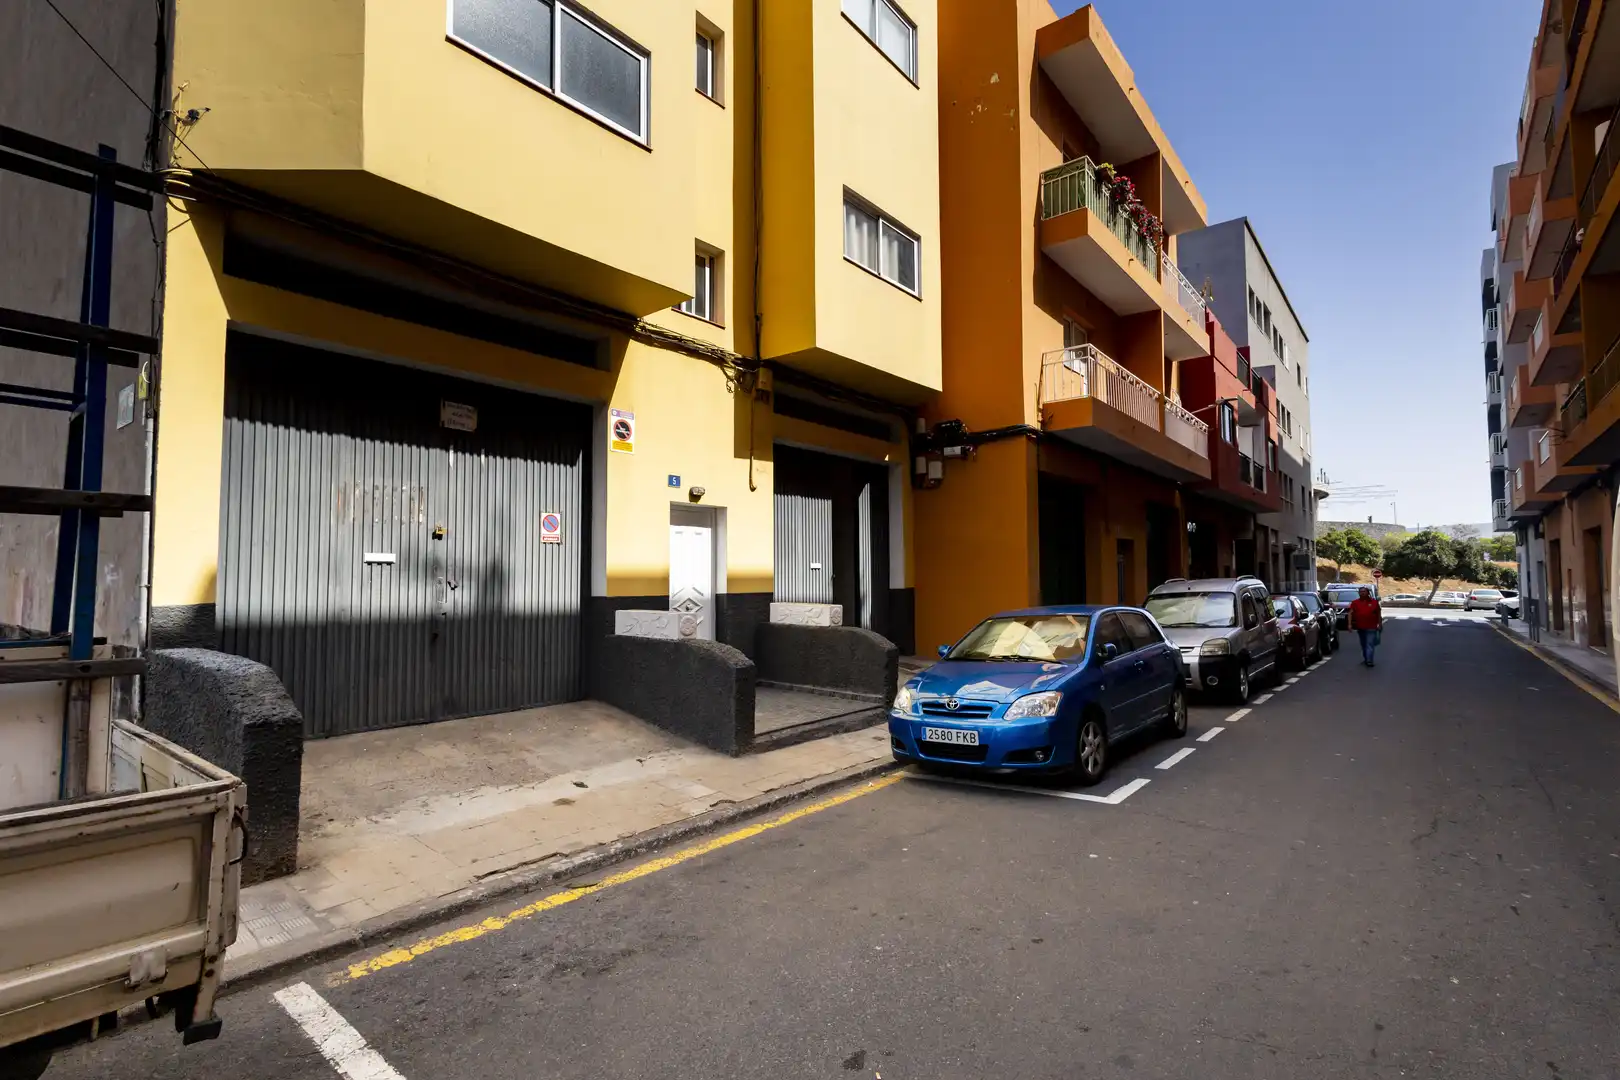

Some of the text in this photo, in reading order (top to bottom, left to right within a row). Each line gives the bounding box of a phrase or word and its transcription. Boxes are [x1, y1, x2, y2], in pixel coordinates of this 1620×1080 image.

[672, 476, 677, 485] 5
[928, 729, 977, 744] 2580 FKB
